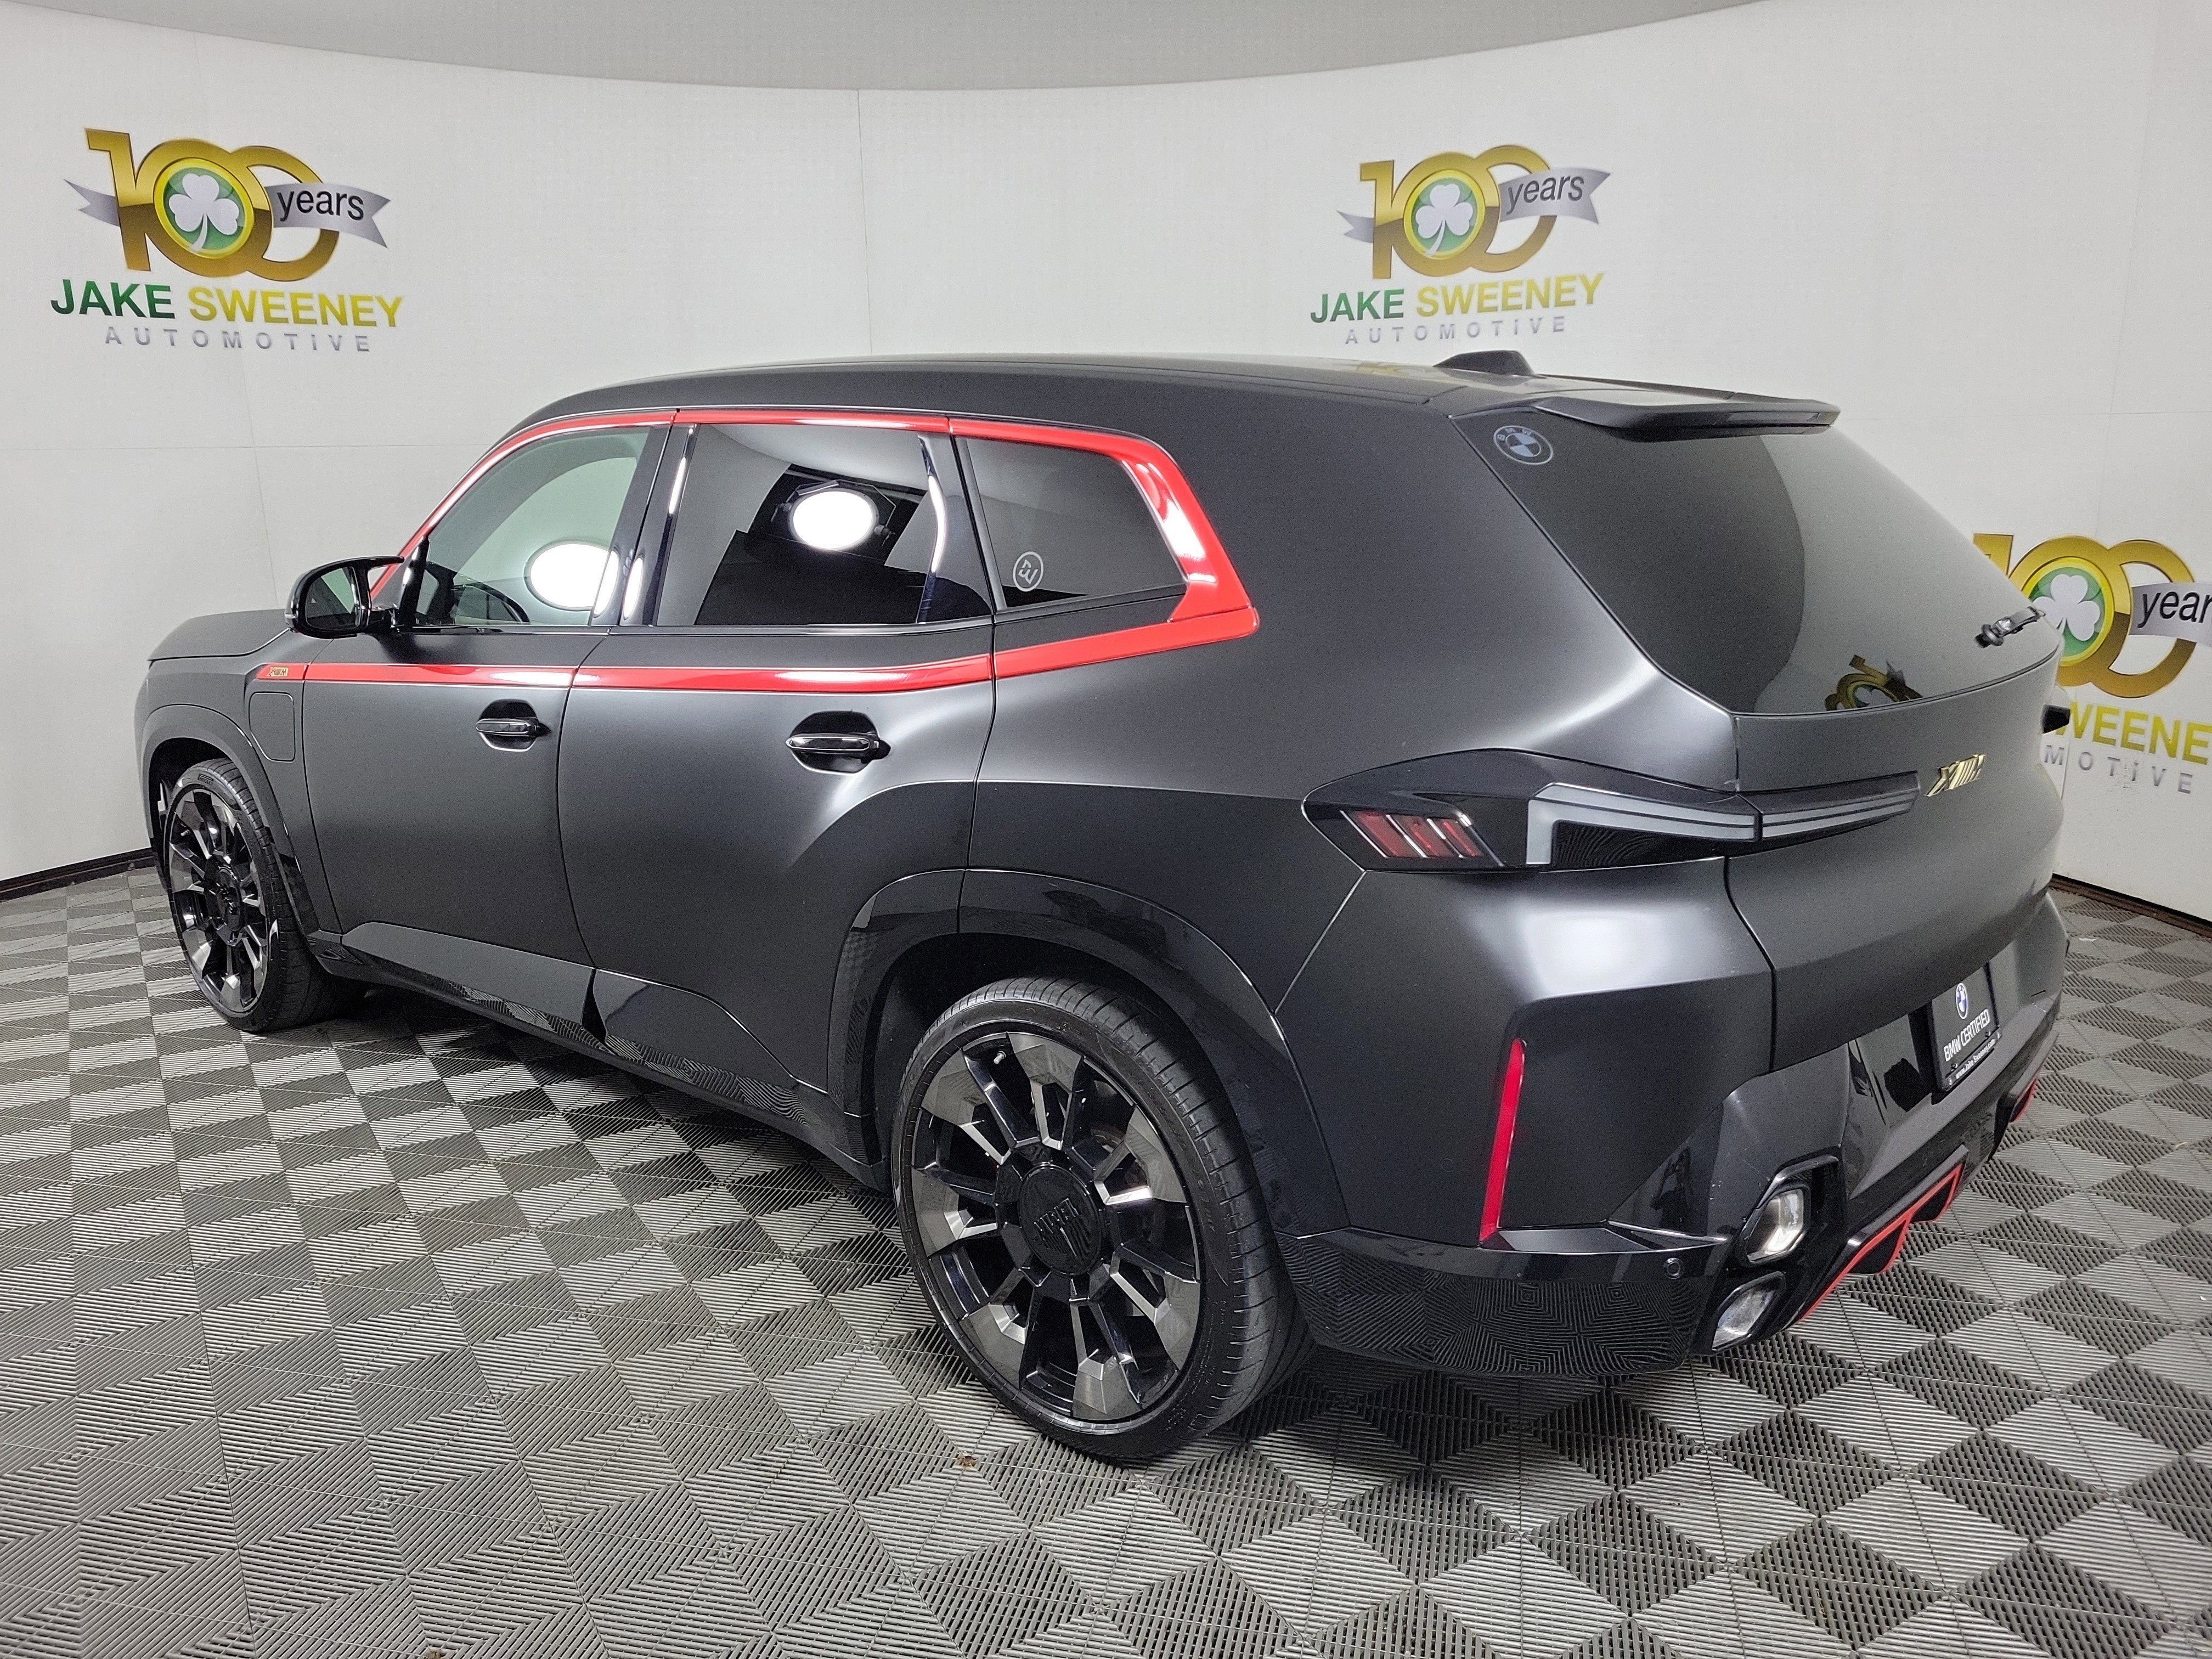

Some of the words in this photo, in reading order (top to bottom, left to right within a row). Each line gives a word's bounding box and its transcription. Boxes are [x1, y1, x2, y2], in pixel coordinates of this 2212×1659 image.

[84, 127, 339, 281] 100
[276, 190, 364, 222] years
[1359, 144, 1558, 279] 100
[1507, 173, 1584, 214] years
[50, 279, 176, 319] JAKE
[188, 286, 403, 328] SWEENEY
[1310, 289, 1404, 323] JAKE
[1416, 272, 1605, 318] SWEENEY
[105, 326, 370, 352] AUTOMOTIVE
[1345, 316, 1566, 345] AUTOMOTIVE
[1943, 1035, 1961, 1062] BMW
[1960, 1008, 1991, 1047] CERTIFIED
